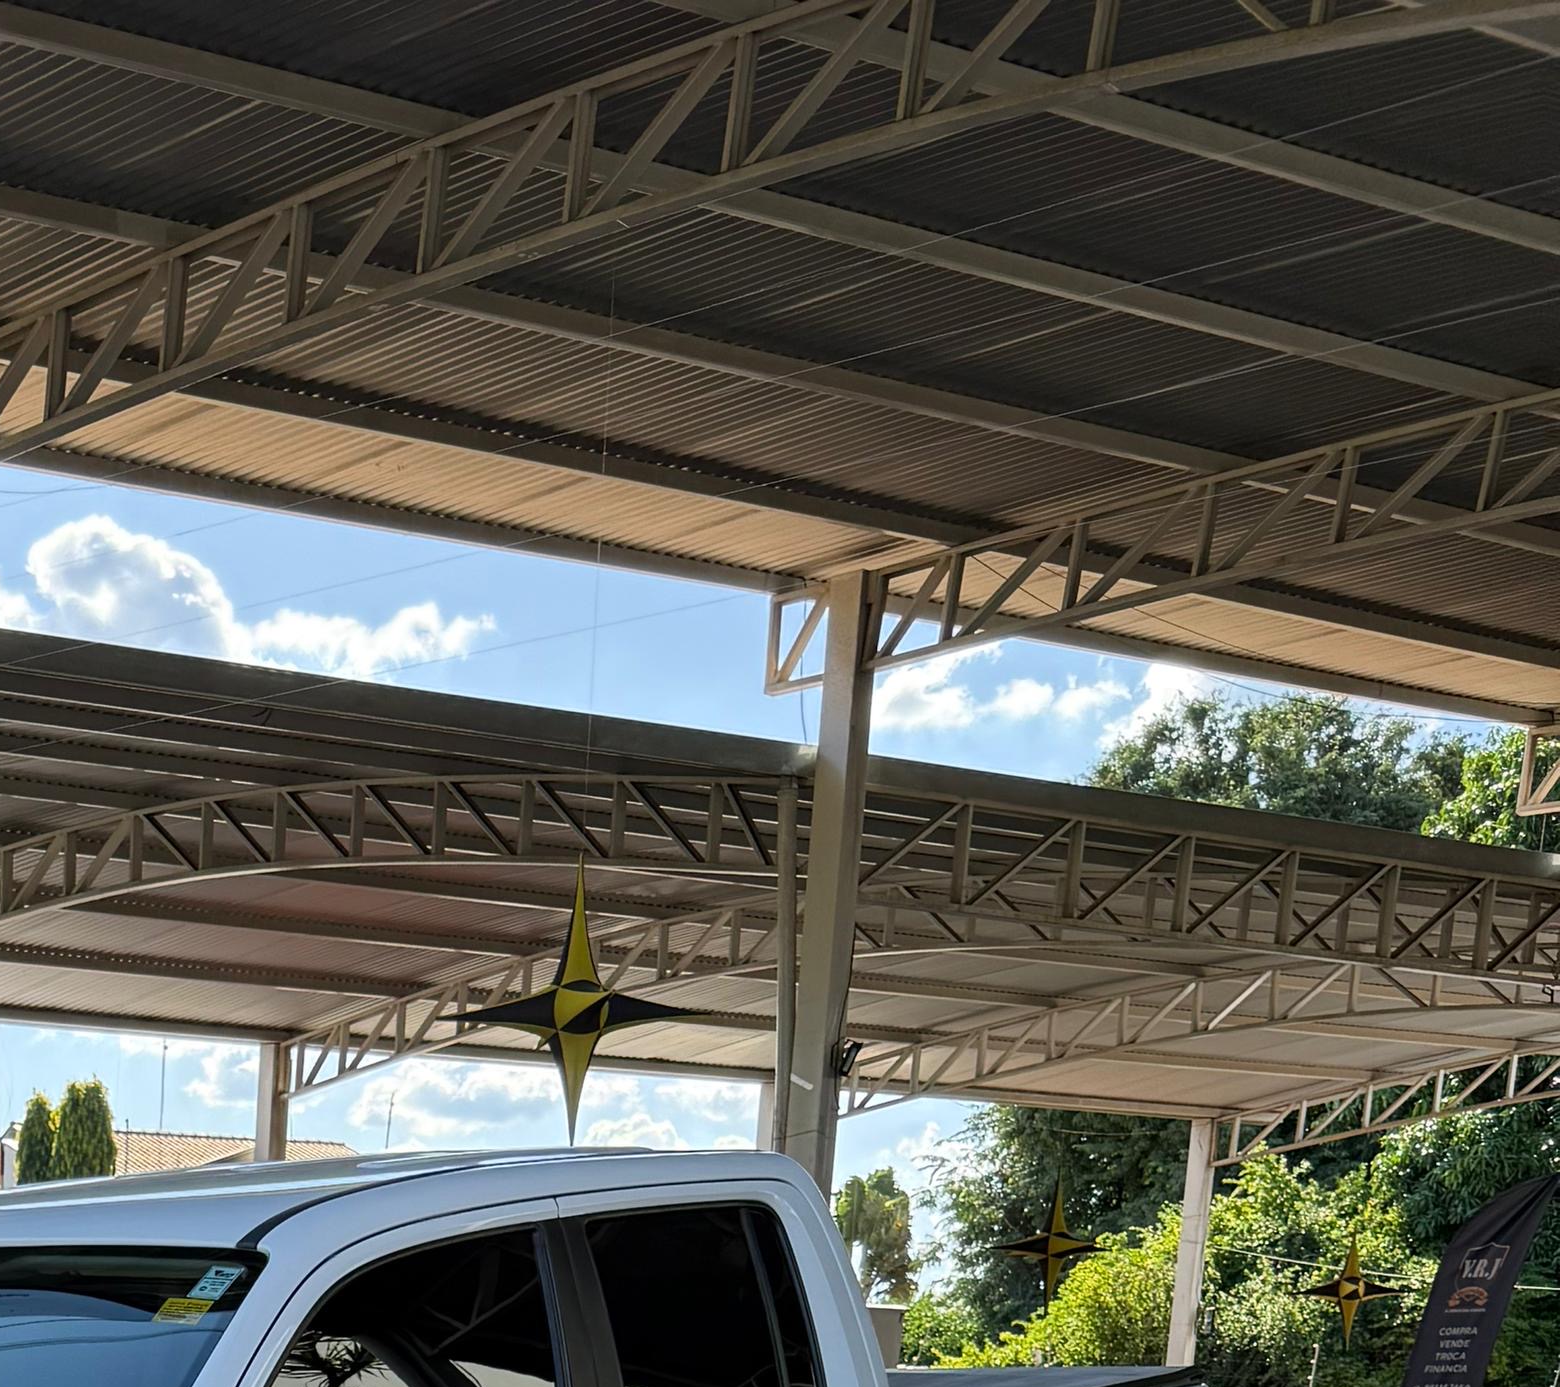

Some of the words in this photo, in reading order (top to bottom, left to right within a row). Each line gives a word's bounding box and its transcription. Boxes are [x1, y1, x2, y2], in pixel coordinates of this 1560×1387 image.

[1439, 1327, 1478, 1336] COMPRA
[1439, 1339, 1472, 1348] VENDE
[1435, 1352, 1466, 1361] TROCA
[1424, 1365, 1467, 1373] FINANCIA
